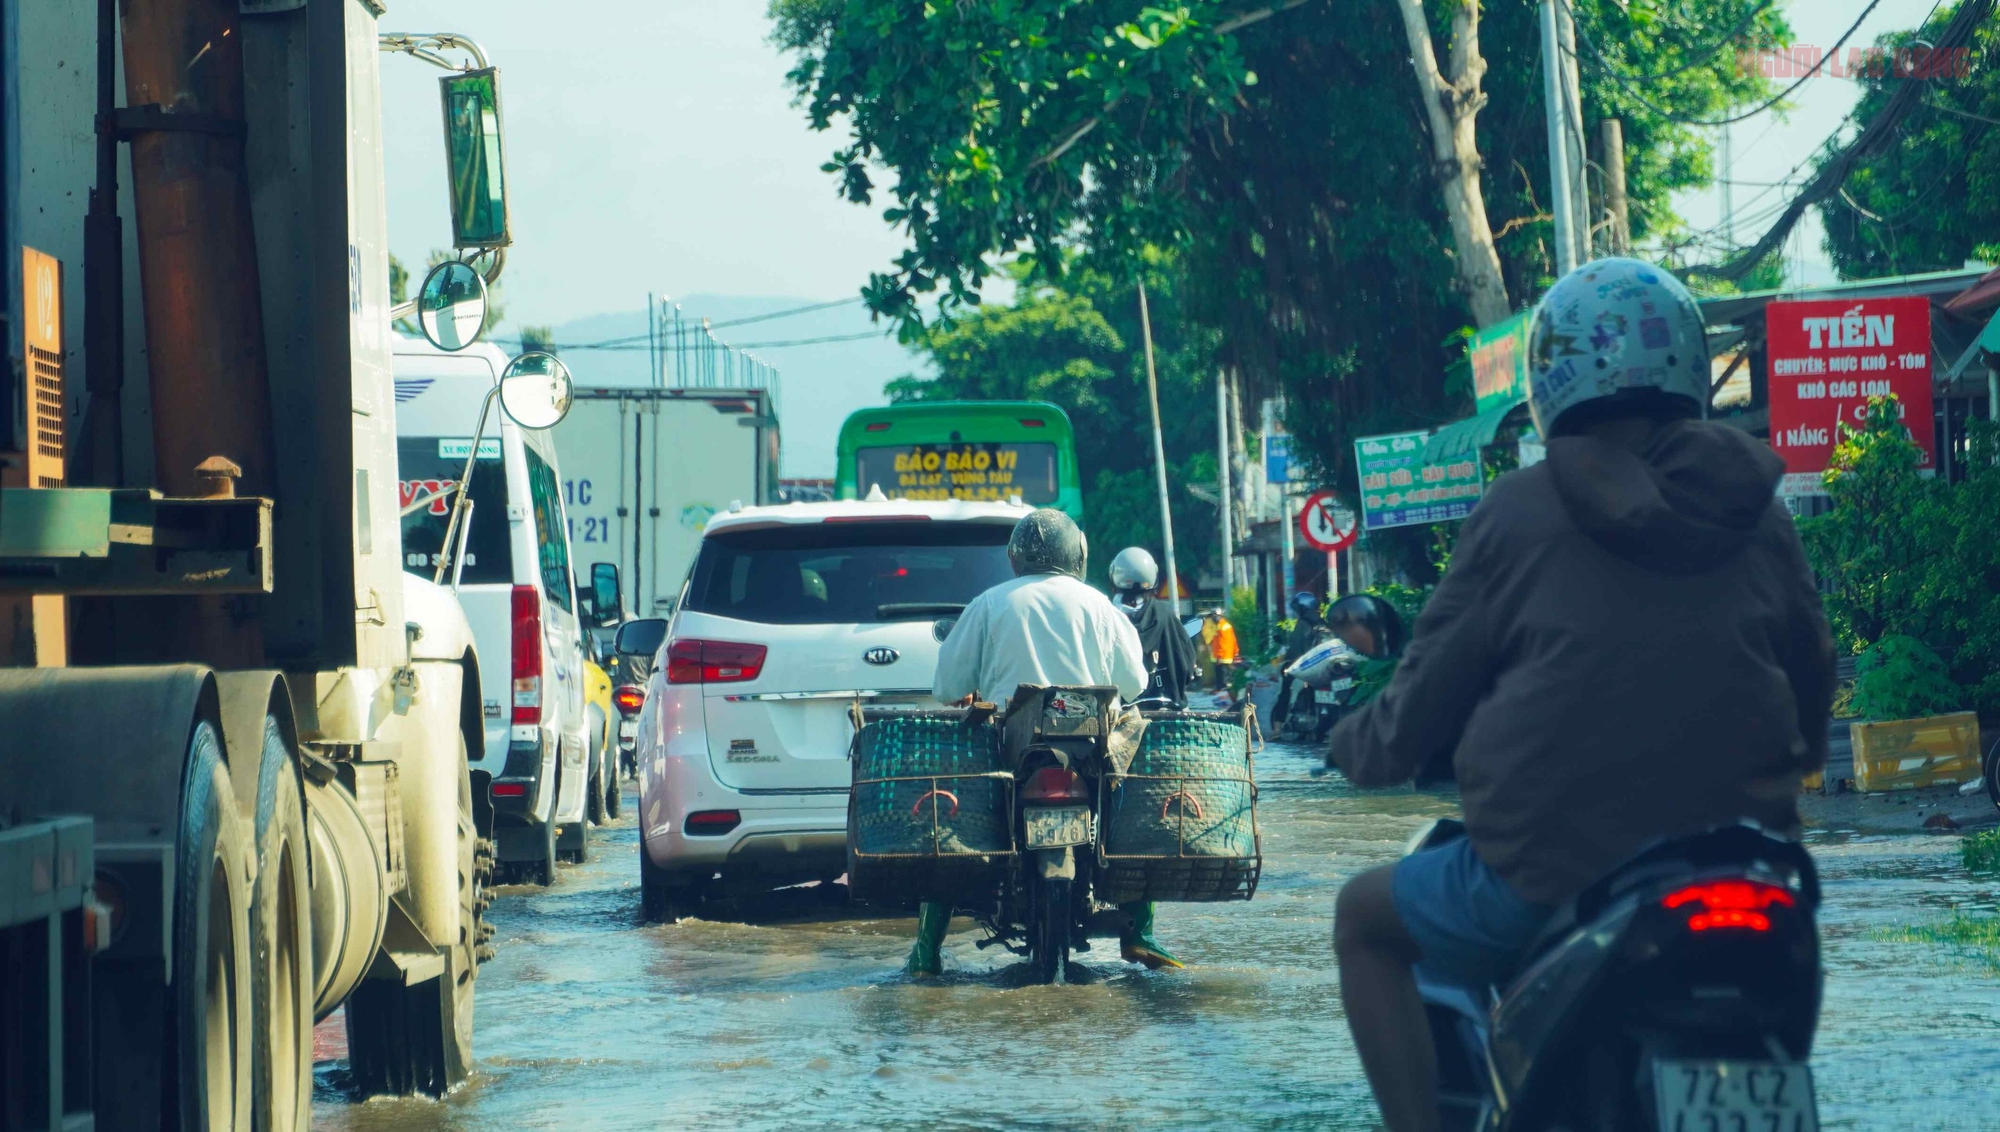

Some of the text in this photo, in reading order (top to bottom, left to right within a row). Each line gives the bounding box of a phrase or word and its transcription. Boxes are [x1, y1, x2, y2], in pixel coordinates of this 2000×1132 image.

[1802, 304, 1895, 349] TIẾN
[1829, 355, 1858, 374] MỰC
[1829, 380, 1858, 398] CÁC
[564, 479, 593, 505] 1C
[868, 650, 894, 662] KIA
